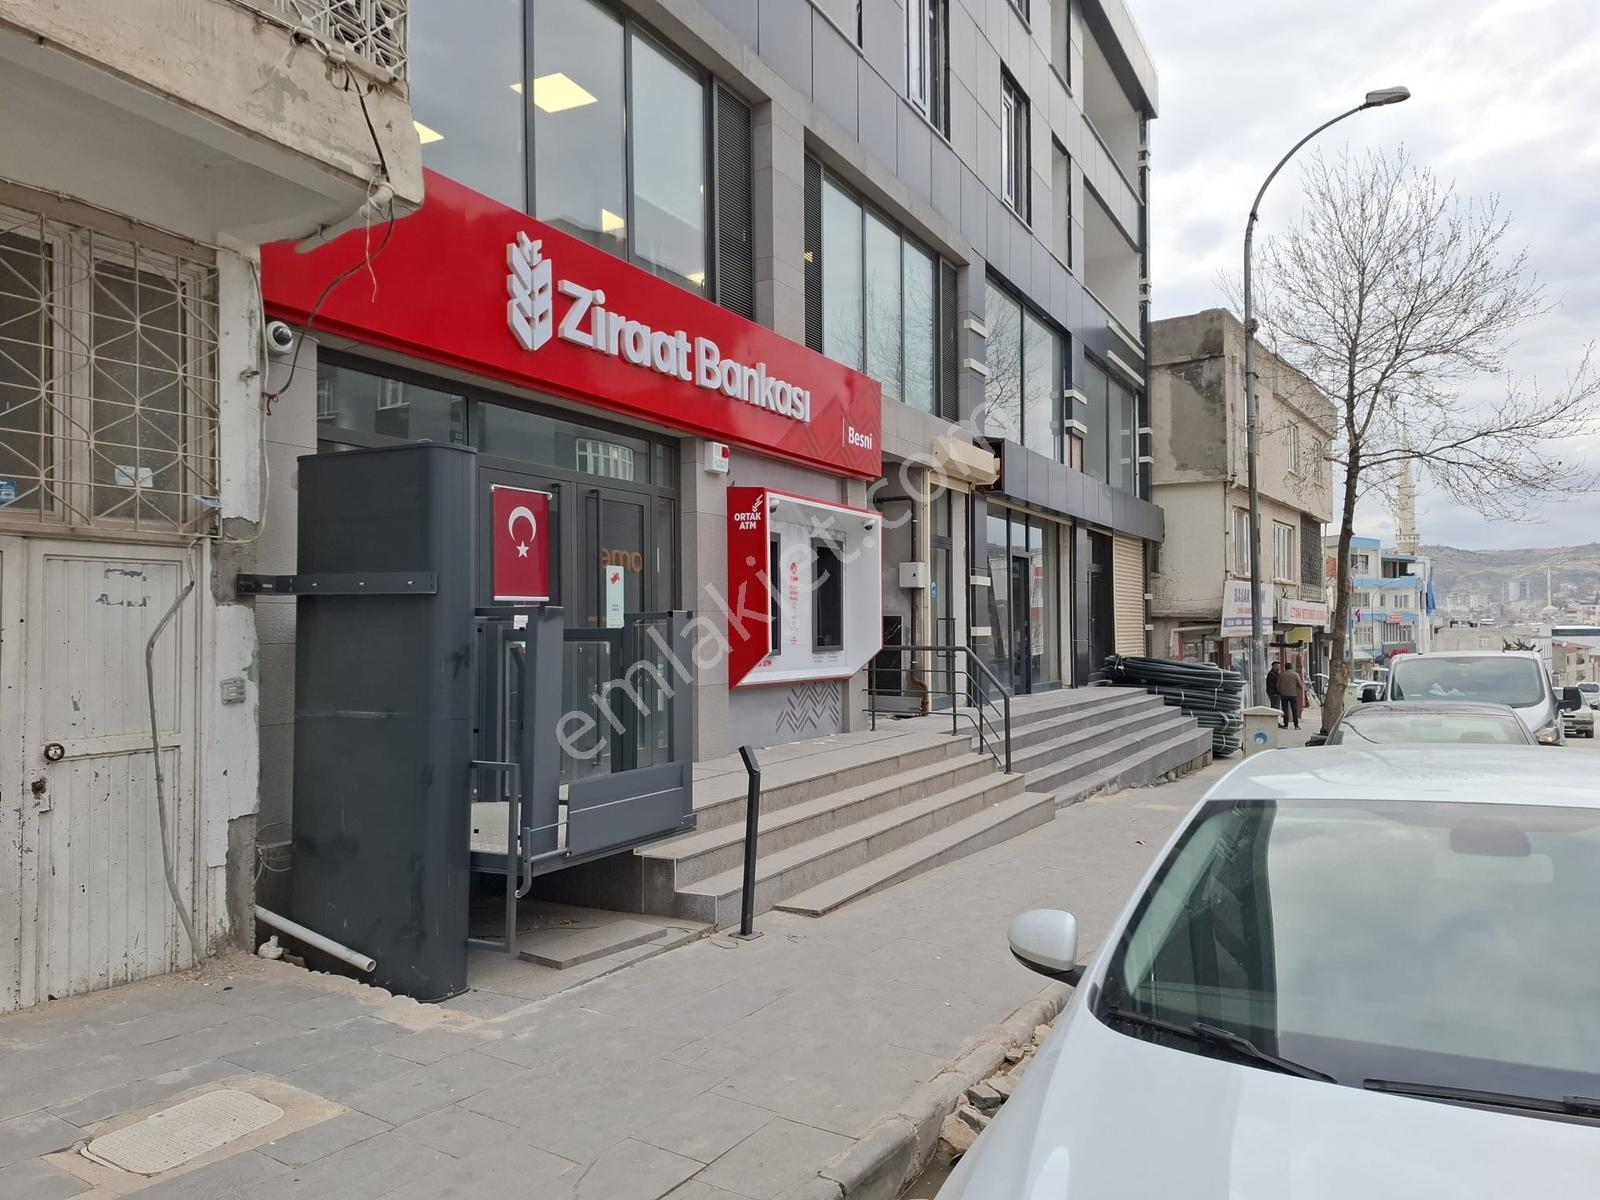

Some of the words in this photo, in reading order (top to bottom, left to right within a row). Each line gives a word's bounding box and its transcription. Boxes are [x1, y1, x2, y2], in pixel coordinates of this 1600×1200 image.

[558, 279, 692, 382] Ziraat
[695, 336, 811, 422] Bankası
[848, 426, 873, 451] Besni
[734, 512, 762, 522] ORTAK
[739, 521, 757, 530] ATM
